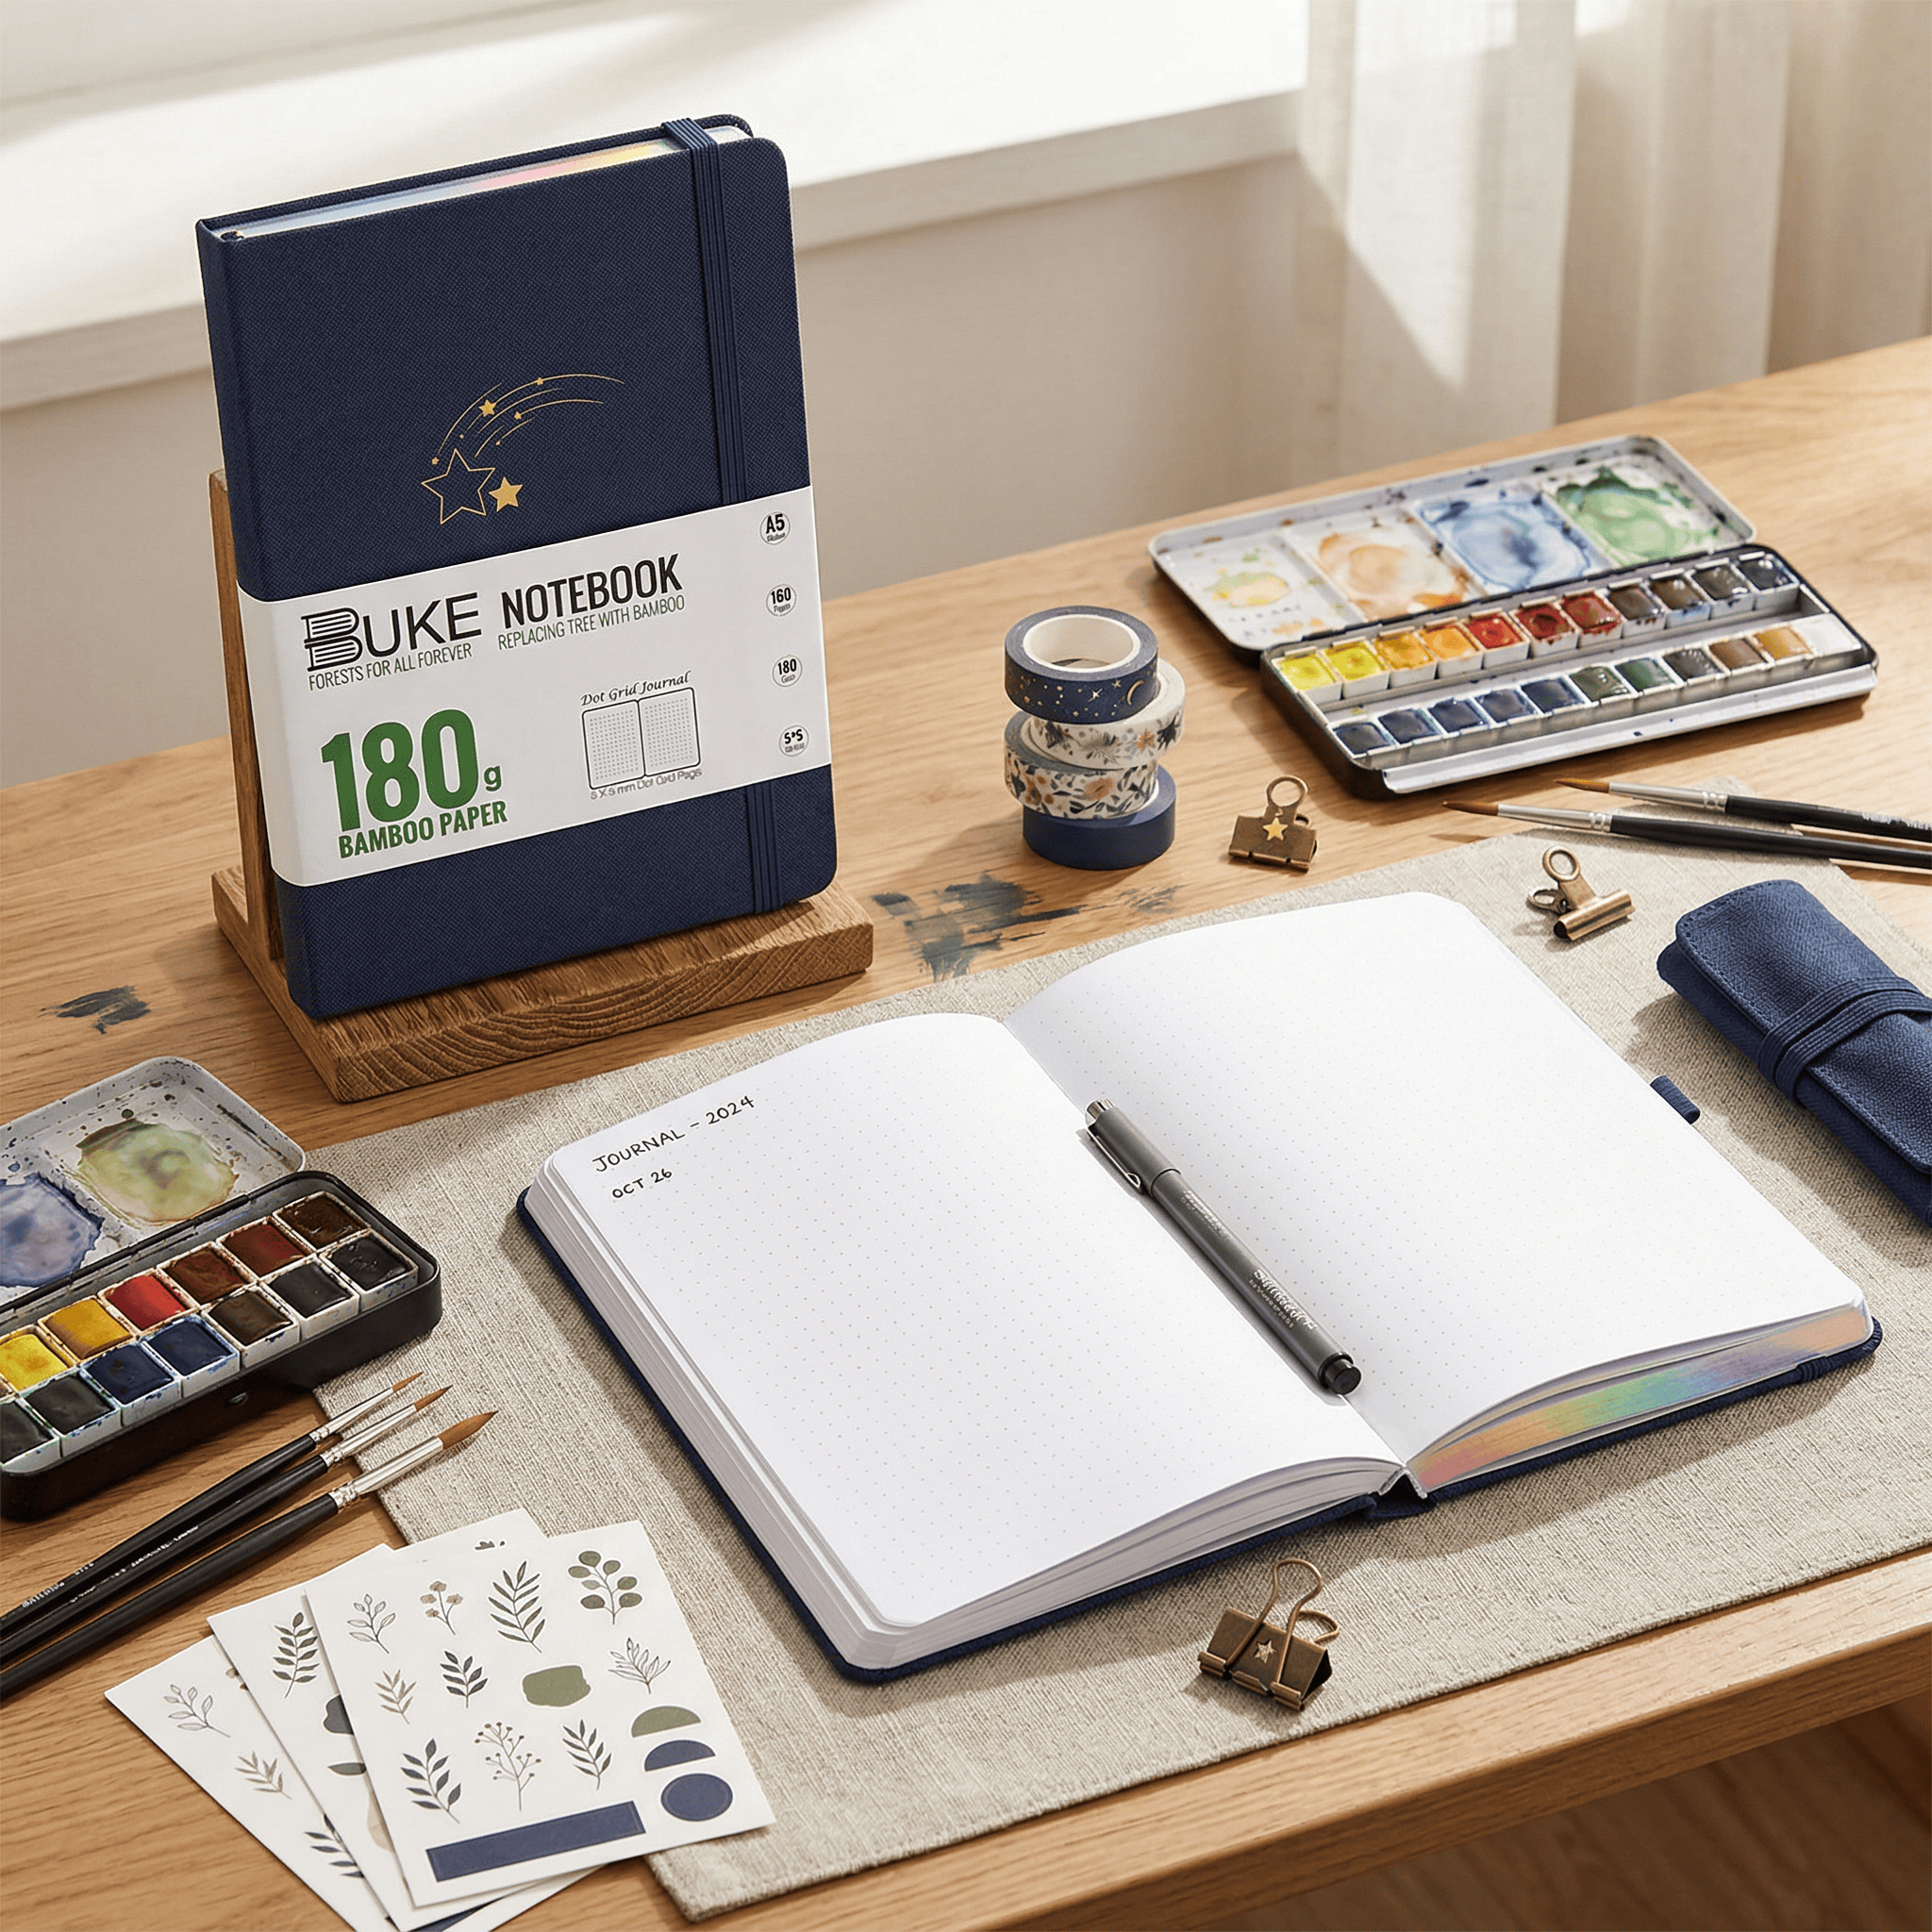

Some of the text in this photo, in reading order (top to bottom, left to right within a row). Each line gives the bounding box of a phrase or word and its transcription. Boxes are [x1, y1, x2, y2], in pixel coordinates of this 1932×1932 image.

[766, 513, 785, 534] A5
[501, 553, 683, 629] NOTEBOOK
[771, 587, 791, 605] 160
[301, 592, 482, 672] BUKE
[498, 594, 685, 650] REPLACING TREE WITH BAMBOO
[308, 642, 473, 691] FORESTS FOR ALL FOREVER
[580, 670, 691, 706] Dot Grid Journal
[777, 658, 797, 675] 180
[338, 801, 508, 858] BAMBOO PAPER
[591, 1129, 686, 1173] JOURNAL
[706, 1095, 755, 1124] 2024
[611, 1168, 673, 1198] OCT 26
